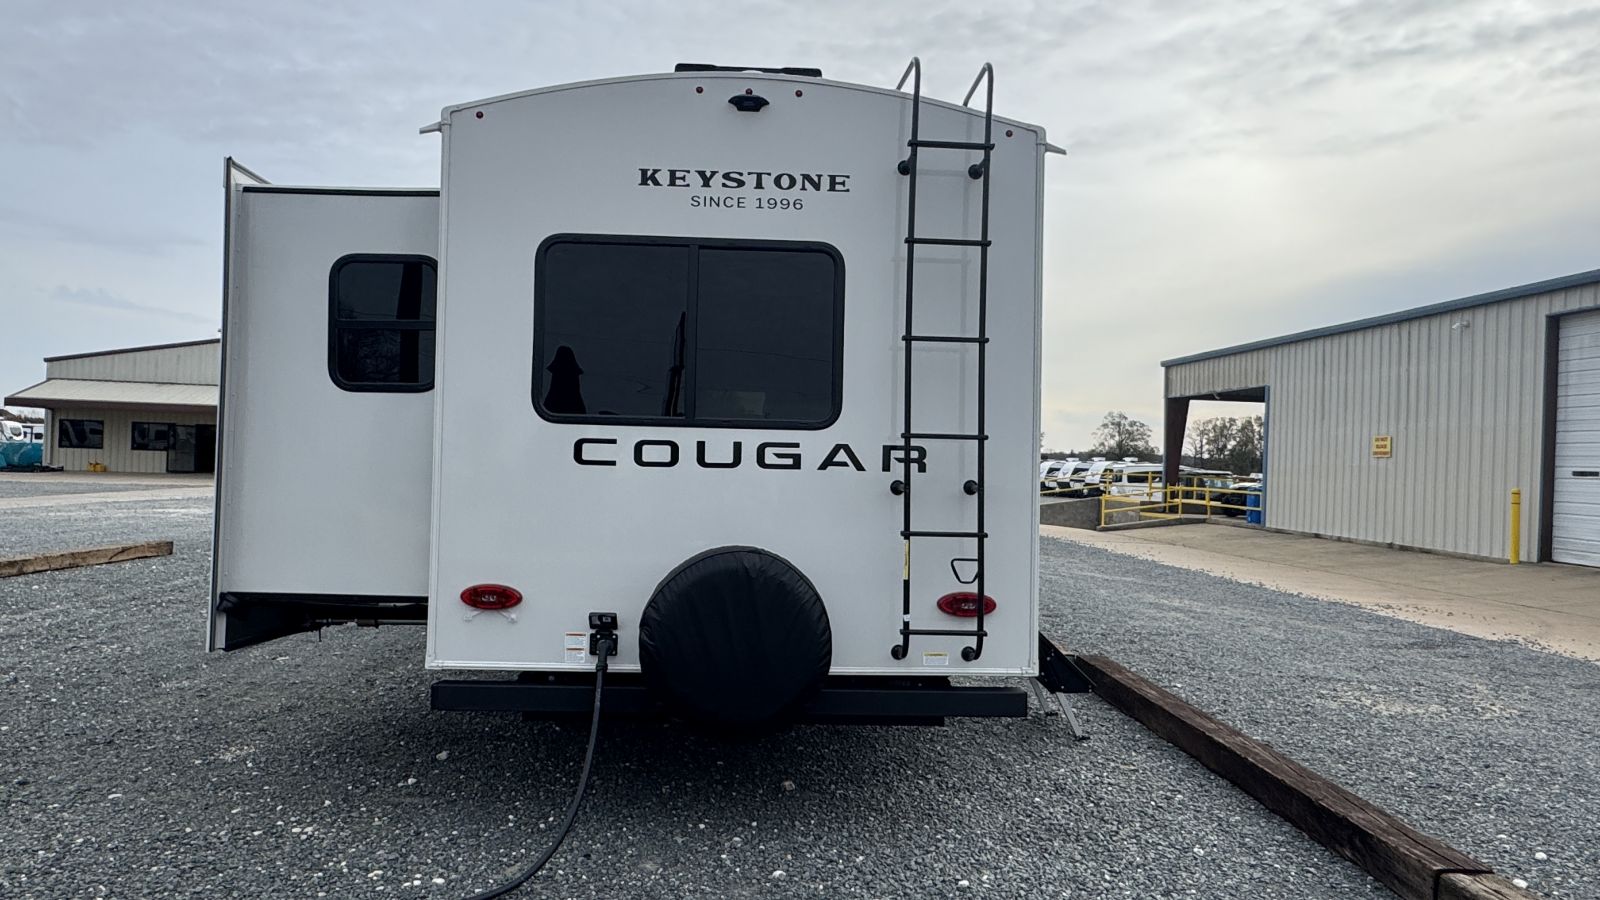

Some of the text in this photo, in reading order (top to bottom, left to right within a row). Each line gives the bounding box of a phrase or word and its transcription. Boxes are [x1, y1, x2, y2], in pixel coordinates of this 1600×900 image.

[638, 168, 850, 192] KEYSTONE
[690, 195, 804, 210] SINCE 1996
[573, 437, 927, 473] COUGAR
